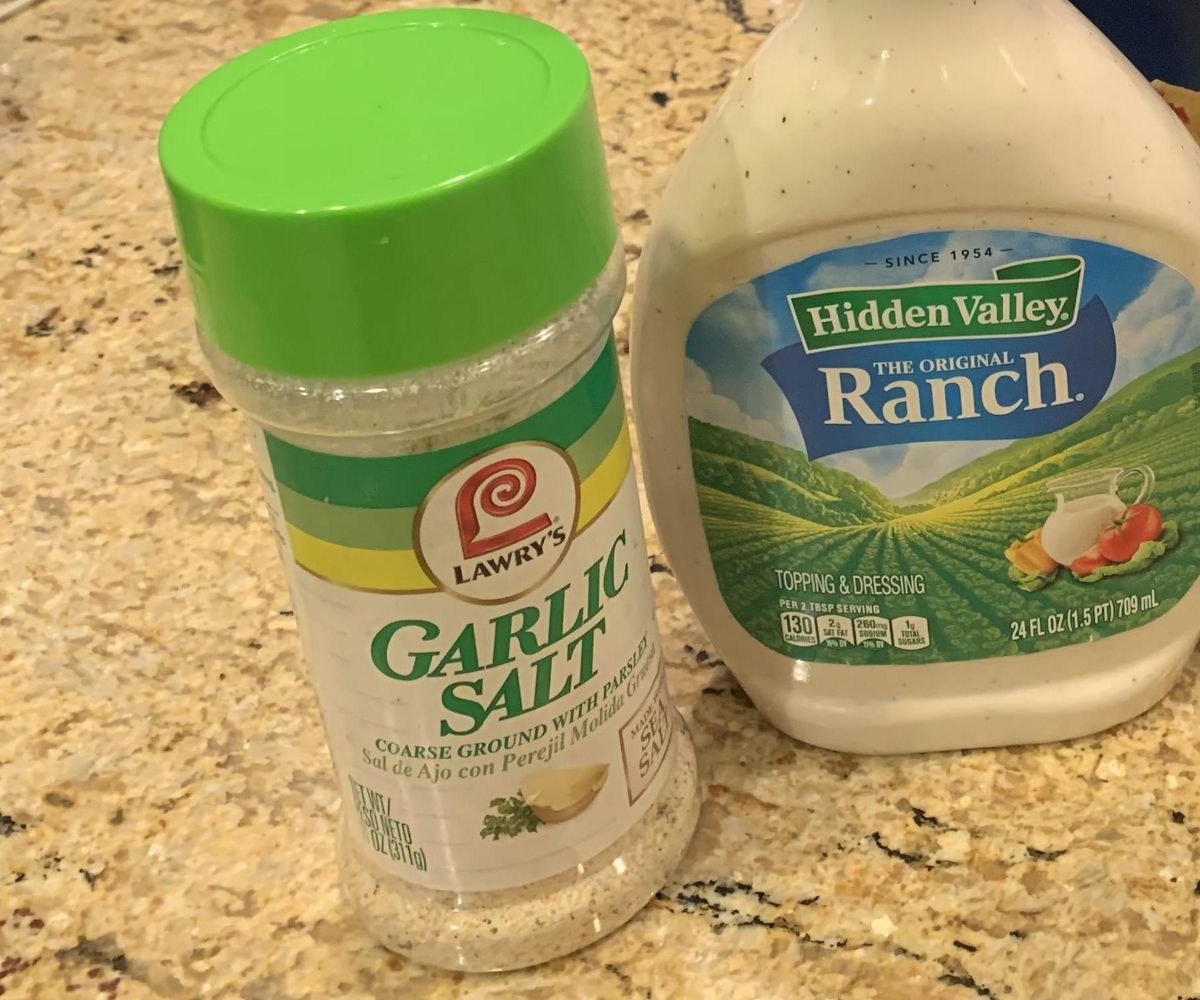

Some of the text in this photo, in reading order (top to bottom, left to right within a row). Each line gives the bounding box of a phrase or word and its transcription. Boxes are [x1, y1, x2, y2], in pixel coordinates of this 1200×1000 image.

[884, 245, 994, 269] SINCE 1954
[806, 291, 1067, 338] Hidden Valley
[873, 350, 1014, 376] THE ORIGINAL
[818, 352, 1076, 426] Ranch
[453, 525, 567, 585] LAWRY'S
[371, 529, 629, 682] GARLIC
[775, 569, 926, 595] TOPPING & DRESSING
[779, 599, 881, 614] PER 2 TBSP SERVING
[783, 614, 813, 635] 130
[1011, 588, 1159, 641] 24 FL OZ (1.5 PT) 709 mL
[900, 630, 921, 638] TOTAL
[375, 737, 452, 760] COARSE
[457, 723, 548, 759] GROUND
[552, 691, 598, 732] WITH
[602, 631, 648, 699] PARSLEY
[440, 616, 606, 737] SALT
[362, 747, 387, 772] Sal
[392, 760, 412, 777] de
[417, 760, 451, 784] Ajo
[458, 761, 495, 779] con
[502, 737, 565, 773] Perejil
[570, 693, 625, 746] Molida
[380, 814, 412, 844] NETO
